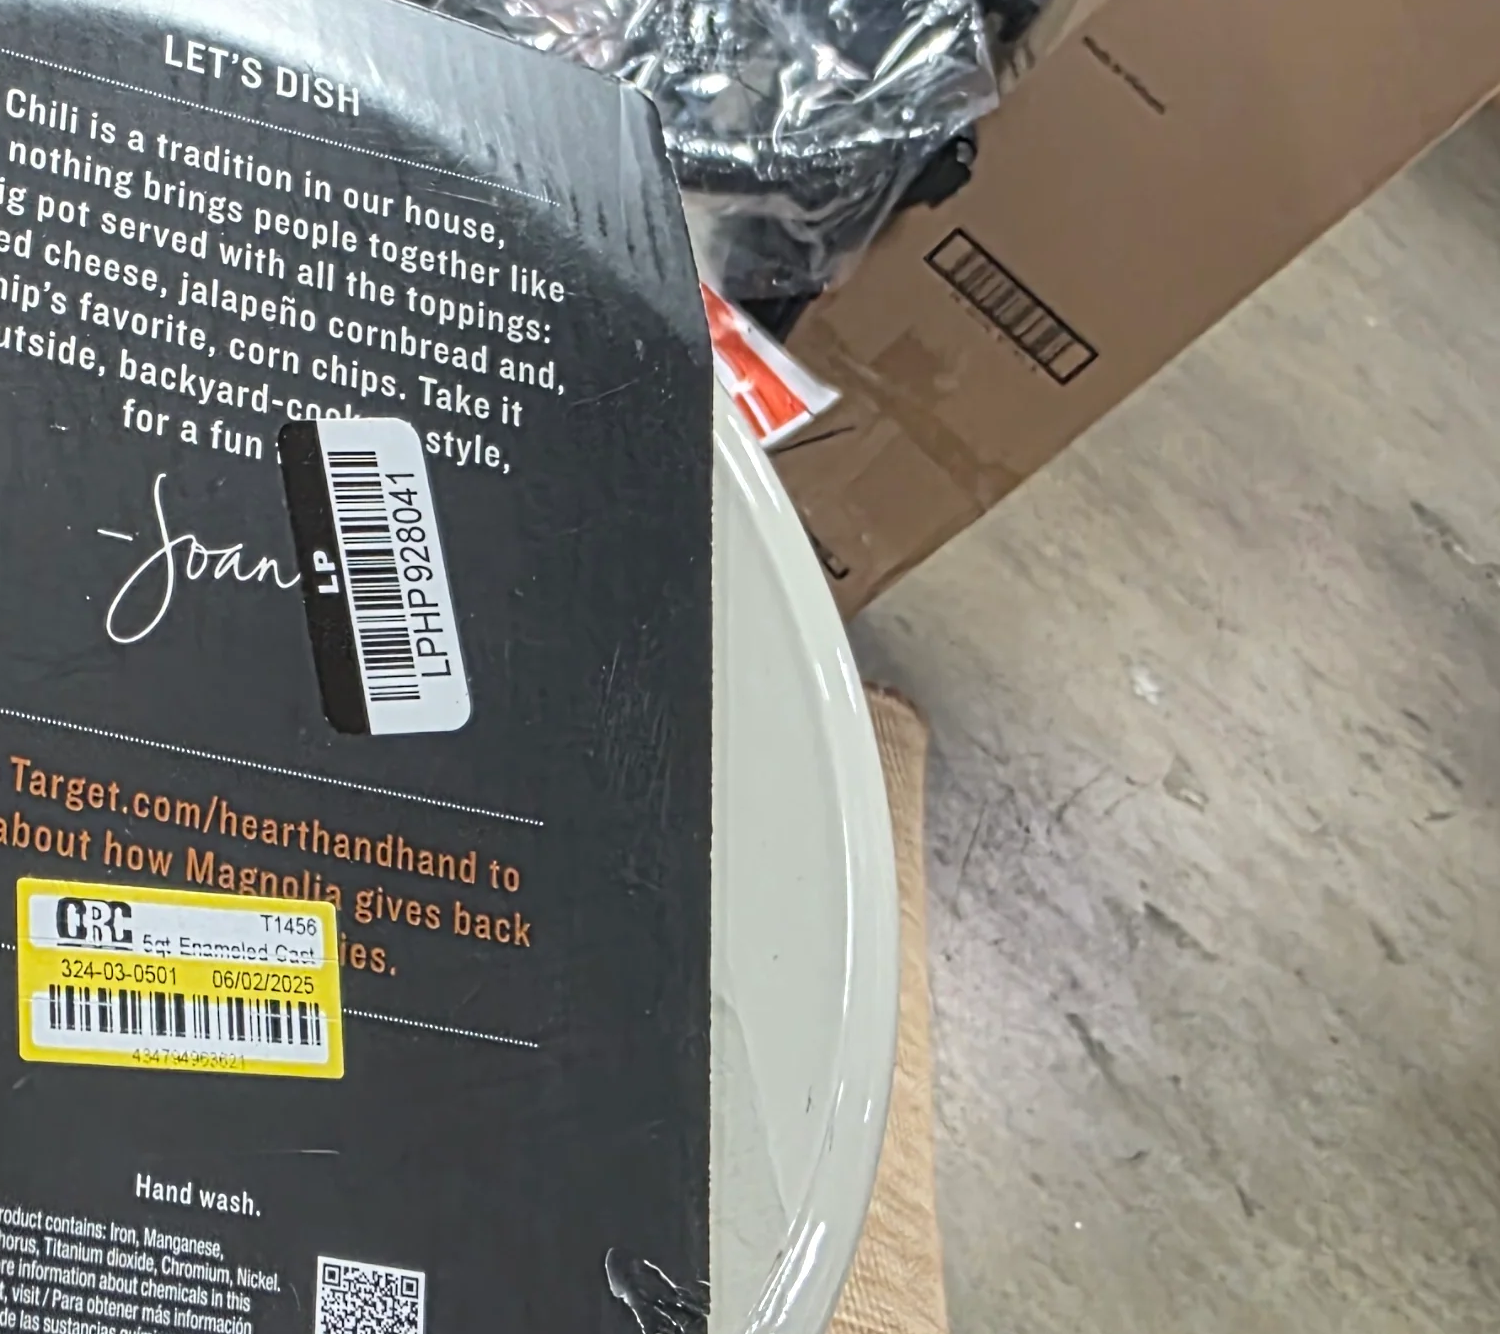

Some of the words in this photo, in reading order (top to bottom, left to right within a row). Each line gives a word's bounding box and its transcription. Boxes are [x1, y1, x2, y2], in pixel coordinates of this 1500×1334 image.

[165, 34, 262, 88] LET'S
[276, 65, 362, 117] DISH
[6, 88, 78, 134] Chili
[90, 112, 116, 144] is
[127, 130, 144, 153] a
[157, 134, 292, 192] tradition
[305, 170, 331, 203] in
[343, 188, 394, 217] our
[405, 195, 504, 249] house,
[9, 141, 133, 199] nothing
[144, 170, 243, 224] brings
[255, 207, 357, 252] people
[369, 233, 500, 286] together
[511, 264, 564, 302] like
[37, 194, 90, 227] pot
[101, 212, 208, 259] served
[219, 232, 285, 279] with
[297, 260, 334, 291] all
[346, 271, 395, 306] the
[406, 287, 550, 344] toppings:
[44, 240, 167, 298] cheese,
[178, 271, 316, 332] jalapeño
[329, 317, 487, 374] cornbread
[499, 358, 564, 395] and,
[313, 550, 340, 595] LP
[386, 473, 452, 677] LPHP928041
[10, 756, 476, 883] Target.com/hearthandhand
[489, 861, 519, 891] to
[104, 831, 172, 875] how
[356, 891, 439, 927] gives
[454, 903, 528, 943] back
[260, 914, 317, 936] T1456
[62, 958, 176, 985] 324-03-0501
[212, 970, 314, 994] 06/02/2025
[45, 1216, 106, 1239] contains:
[110, 1222, 139, 1247] Iron,
[144, 1227, 224, 1261] Manganese,
[136, 1173, 192, 1205] Hand
[199, 1190, 260, 1217] wash.
[44, 1236, 103, 1264] Titanium
[107, 1247, 157, 1276] dioxide,
[161, 1255, 233, 1287] Chromium,
[237, 1267, 281, 1292] Nickel.
